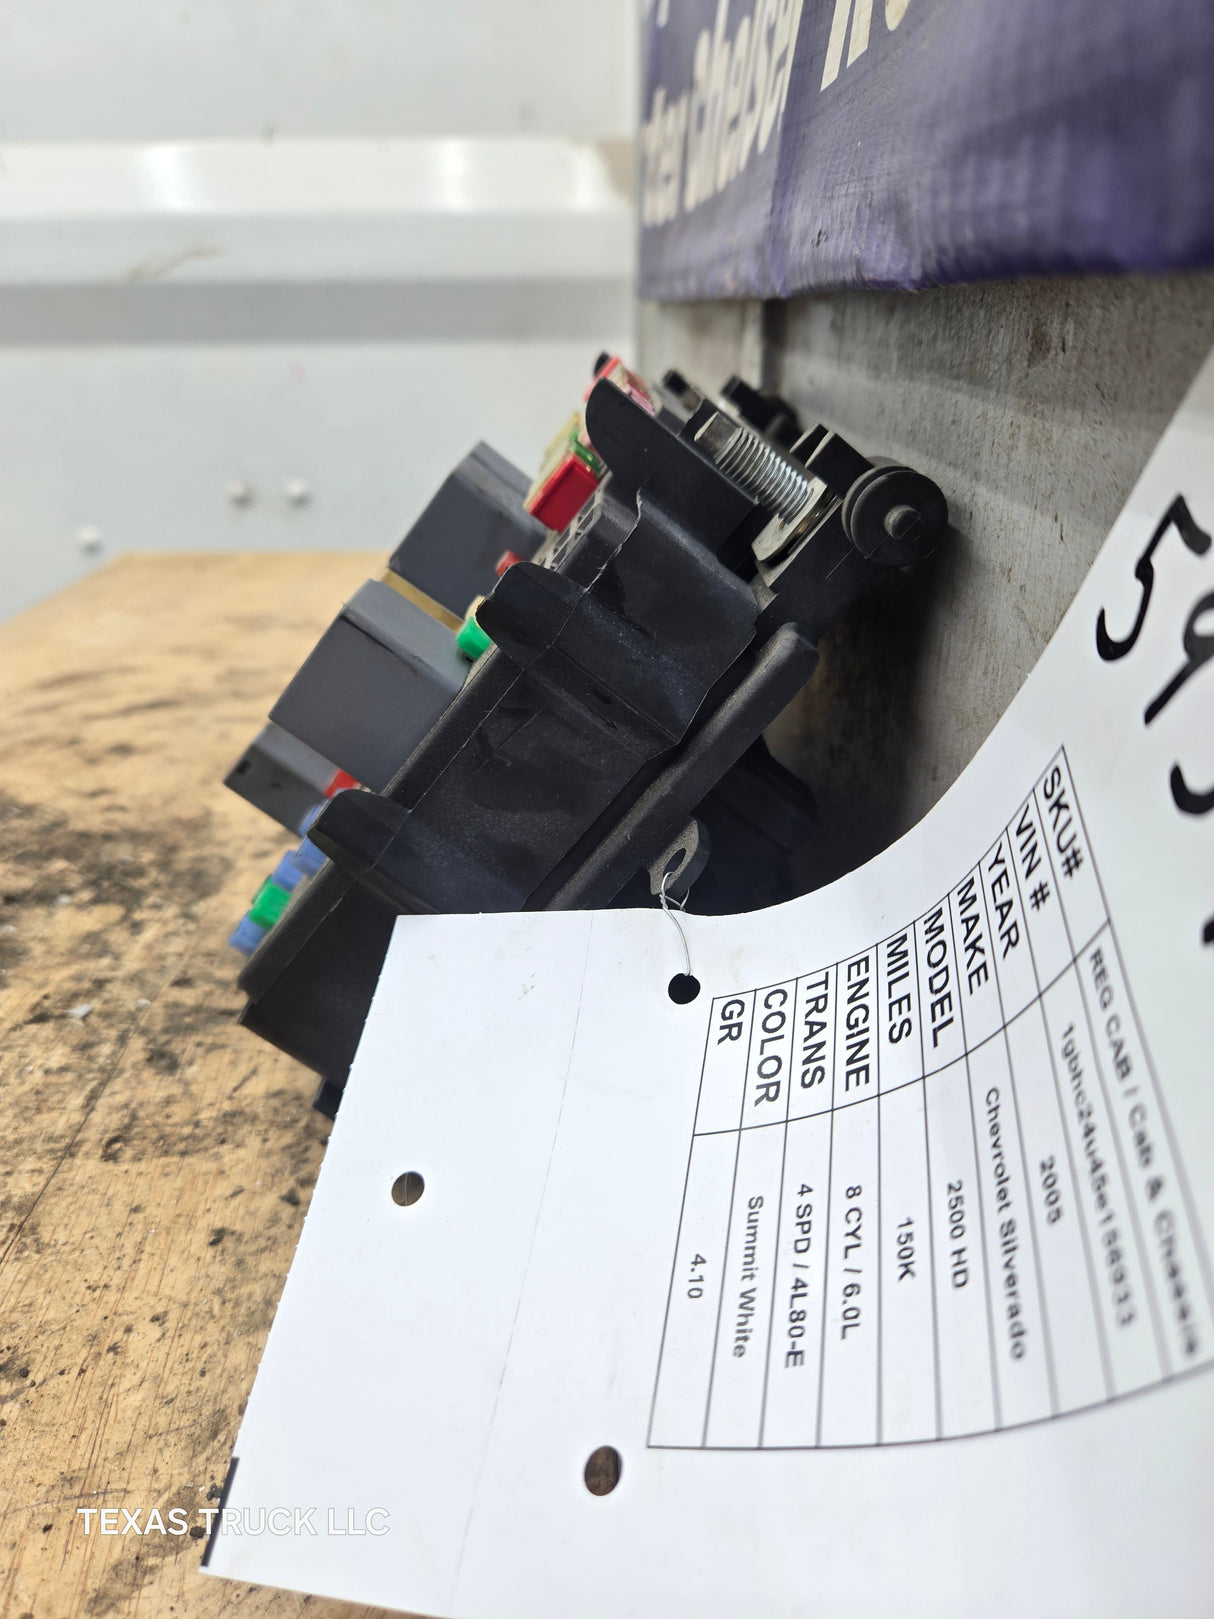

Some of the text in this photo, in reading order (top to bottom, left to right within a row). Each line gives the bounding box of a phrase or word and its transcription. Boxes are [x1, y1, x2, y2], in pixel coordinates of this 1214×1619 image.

[1015, 804, 1050, 912] VIN #
[1043, 766, 1083, 879] SKU#
[957, 876, 989, 996] MAKE
[988, 842, 1020, 960] YEAR
[717, 998, 745, 1045] GR
[800, 971, 829, 1089] TRANS
[845, 955, 870, 1092] ENGINE
[886, 933, 912, 1045] MILES
[923, 906, 954, 1048] MODEL
[754, 988, 788, 1107] COLOR
[1089, 945, 1114, 1011] REG
[1105, 1014, 1132, 1082] CAB
[1128, 1102, 1154, 1169] Cab
[793, 1202, 813, 1255] SPD
[797, 1183, 814, 1197] 4
[843, 1206, 863, 1260] CYL
[845, 1184, 863, 1200] 8
[947, 1179, 969, 1289] 2500 HD
[985, 1086, 1027, 1361] Chevrolet Silverado
[1039, 1154, 1065, 1226] 2005
[687, 1253, 707, 1300] 4.10
[732, 1194, 764, 1359] Summit White
[896, 1216, 917, 1282] 150K
[784, 1276, 809, 1368] 4L80-E
[841, 1281, 861, 1340] 6.0L
